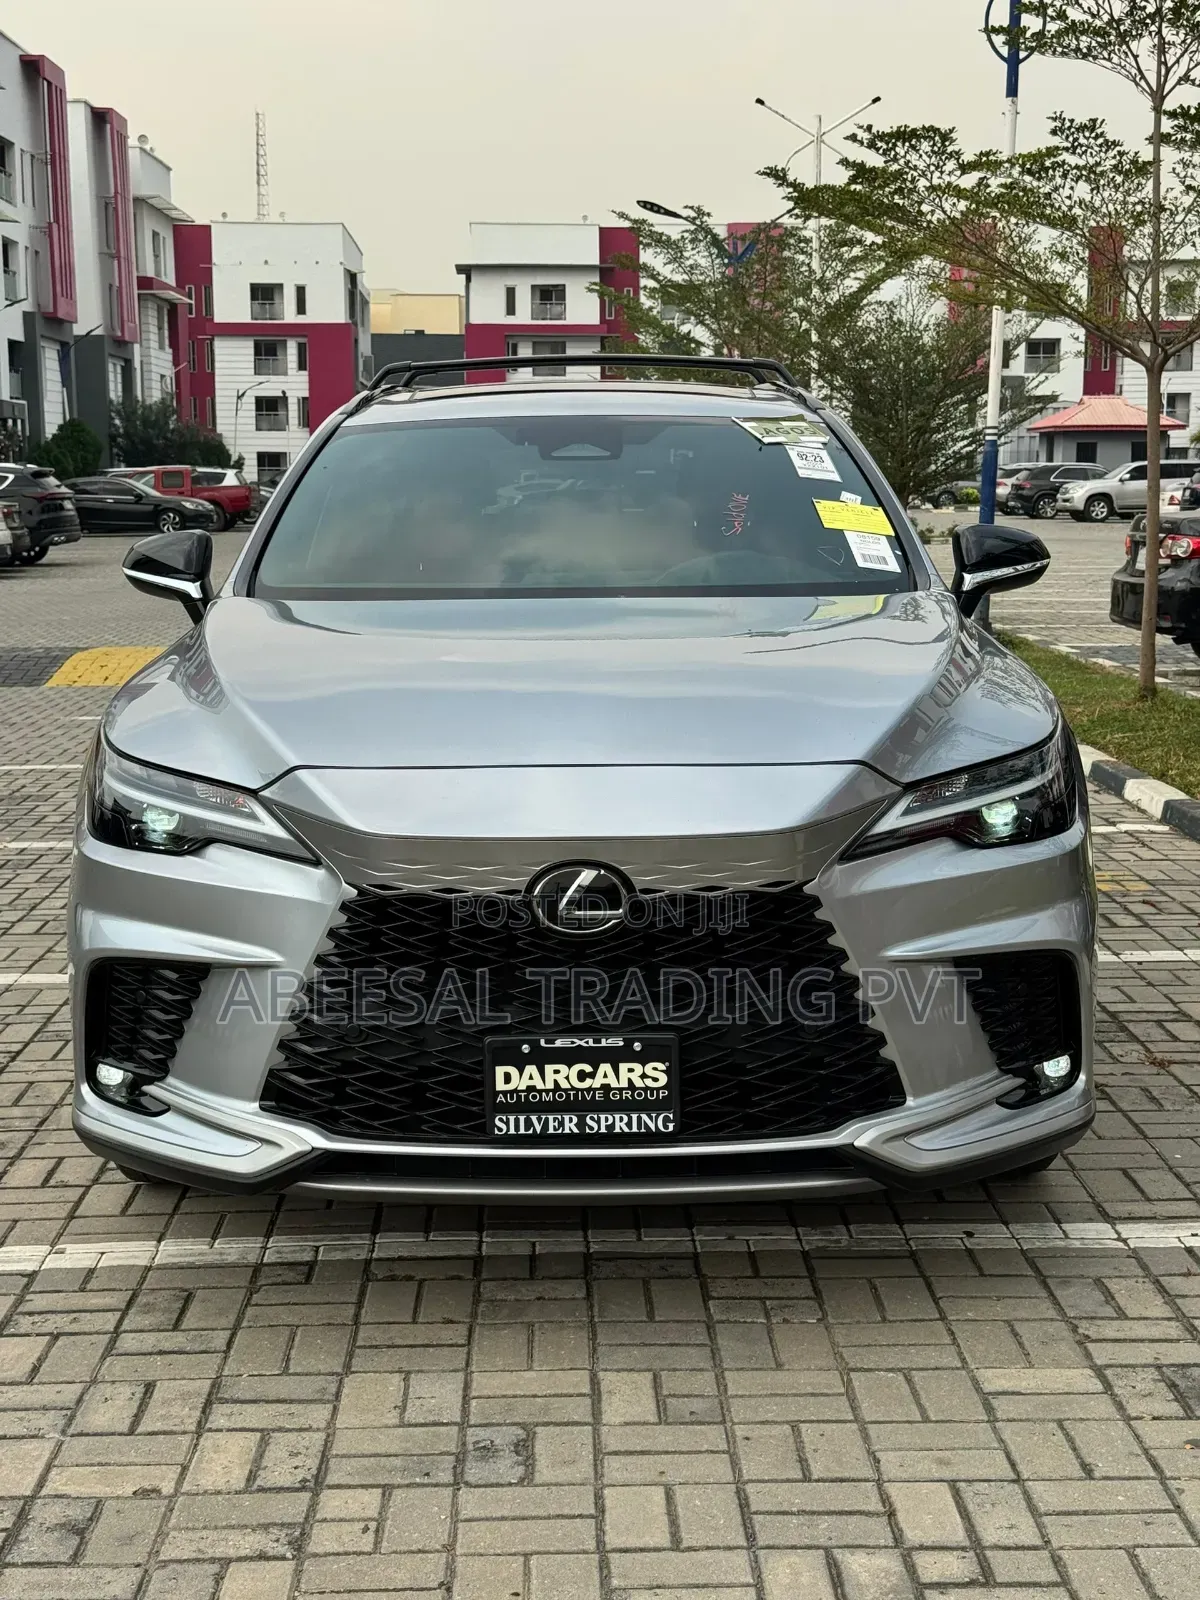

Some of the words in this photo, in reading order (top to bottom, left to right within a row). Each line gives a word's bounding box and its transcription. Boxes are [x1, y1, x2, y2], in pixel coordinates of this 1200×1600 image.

[540, 1037, 624, 1048] LEXUS
[494, 1062, 669, 1091] DARCARS
[496, 1090, 605, 1104] AUTOMOTIVE
[609, 1089, 669, 1100] GROUP
[494, 1114, 579, 1135] SILVER
[585, 1112, 676, 1134] SPRING
